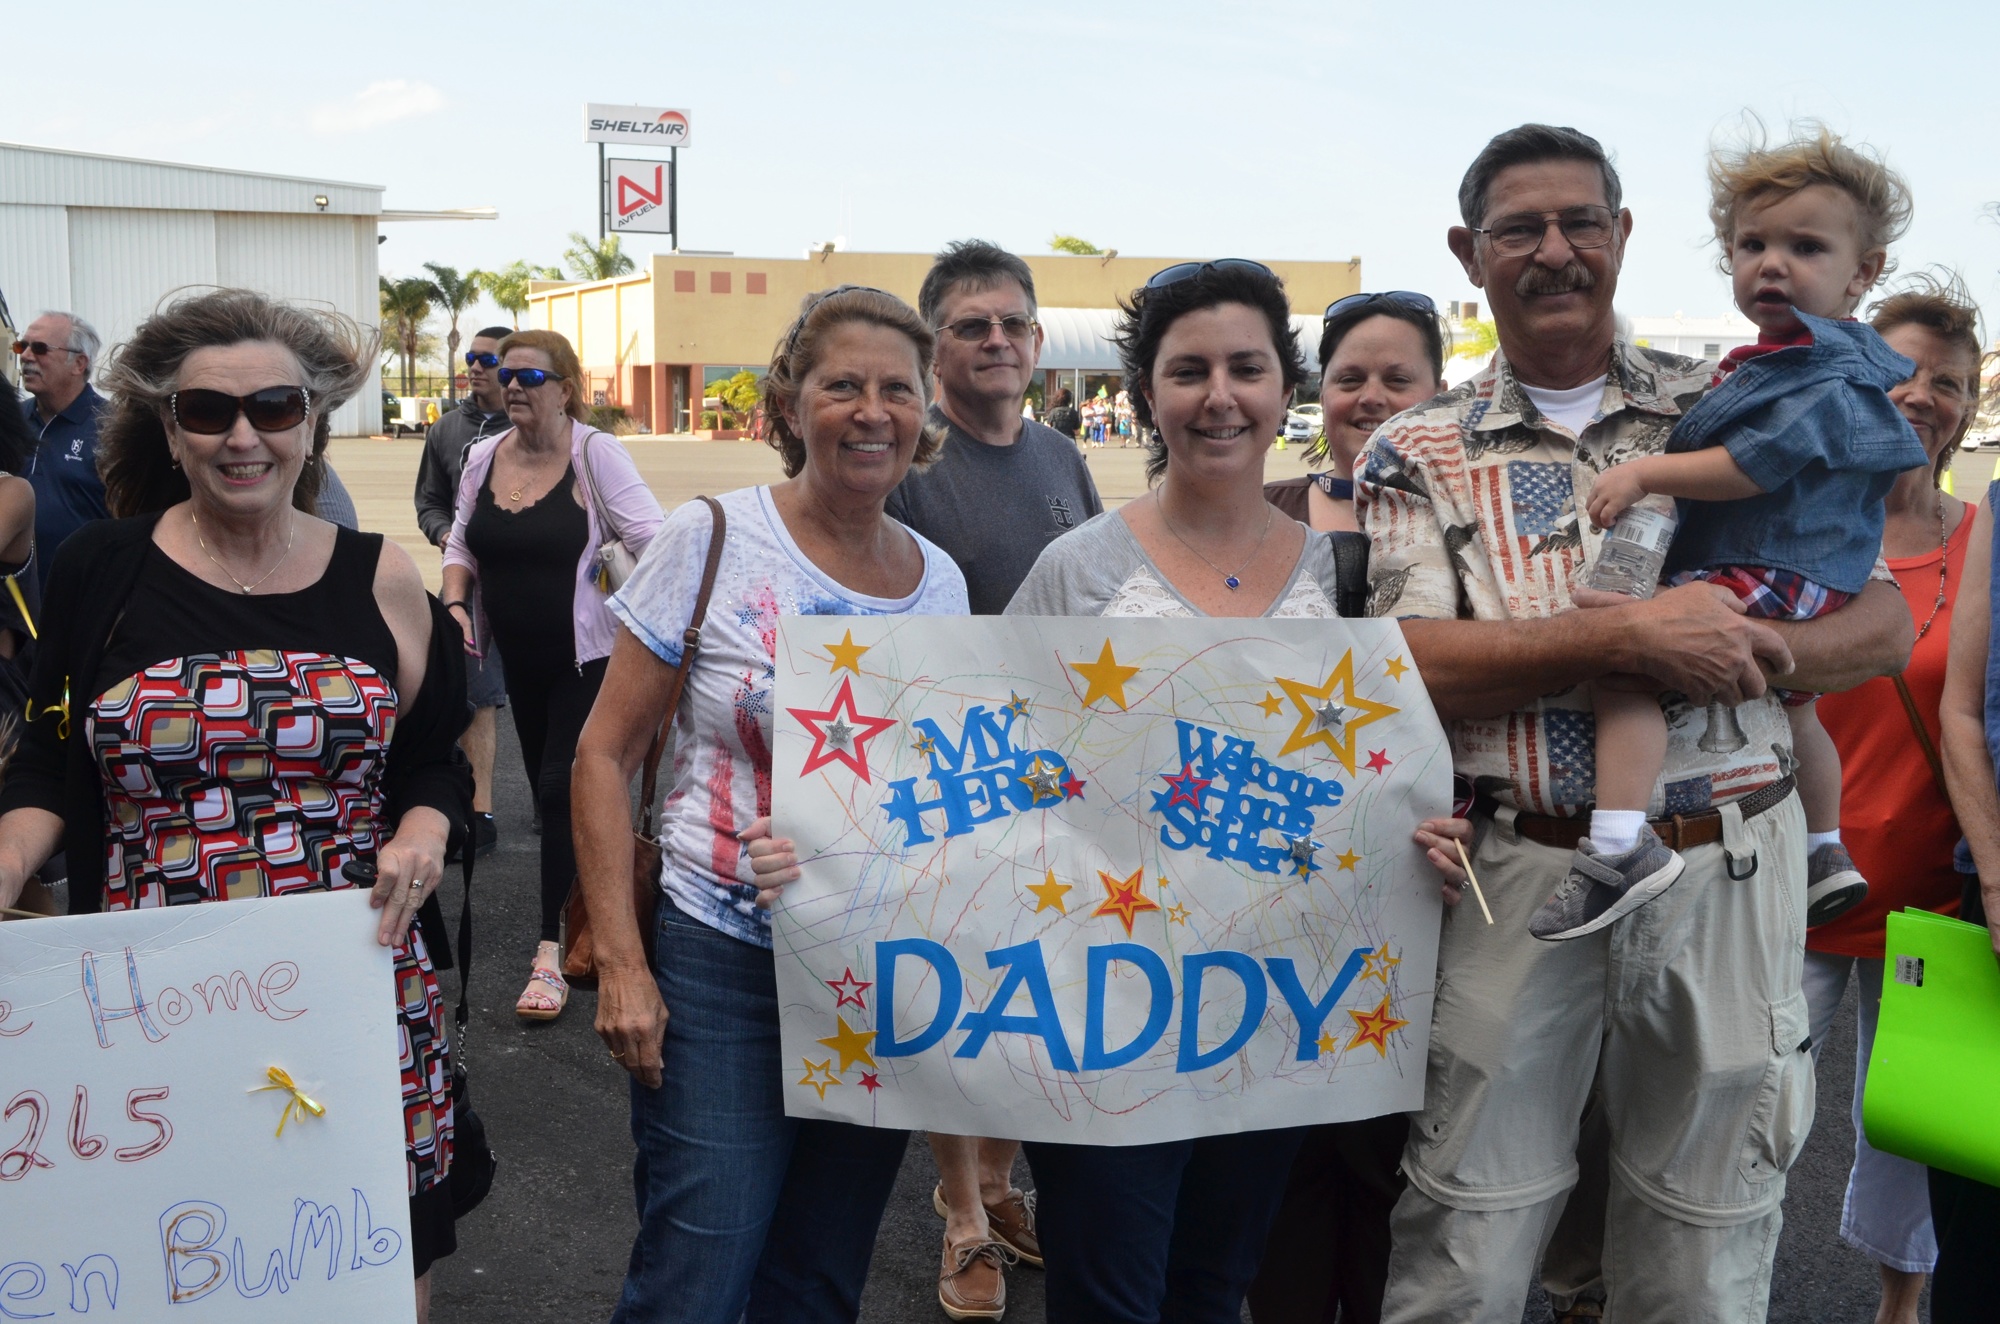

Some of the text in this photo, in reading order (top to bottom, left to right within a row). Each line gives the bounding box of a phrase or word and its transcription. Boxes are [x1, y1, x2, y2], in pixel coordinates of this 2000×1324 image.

[589, 118, 685, 136] SHELTAIR
[617, 203, 657, 228] AVFUEL
[593, 390, 605, 398] PH
[594, 398, 605, 406] 26
[912, 704, 1014, 780] MY
[1174, 719, 1345, 807] Welcome
[887, 749, 1071, 848] HERO
[82, 946, 308, 1049] Home
[874, 937, 1375, 1075] DADDY
[0, 1085, 173, 1181] 265
